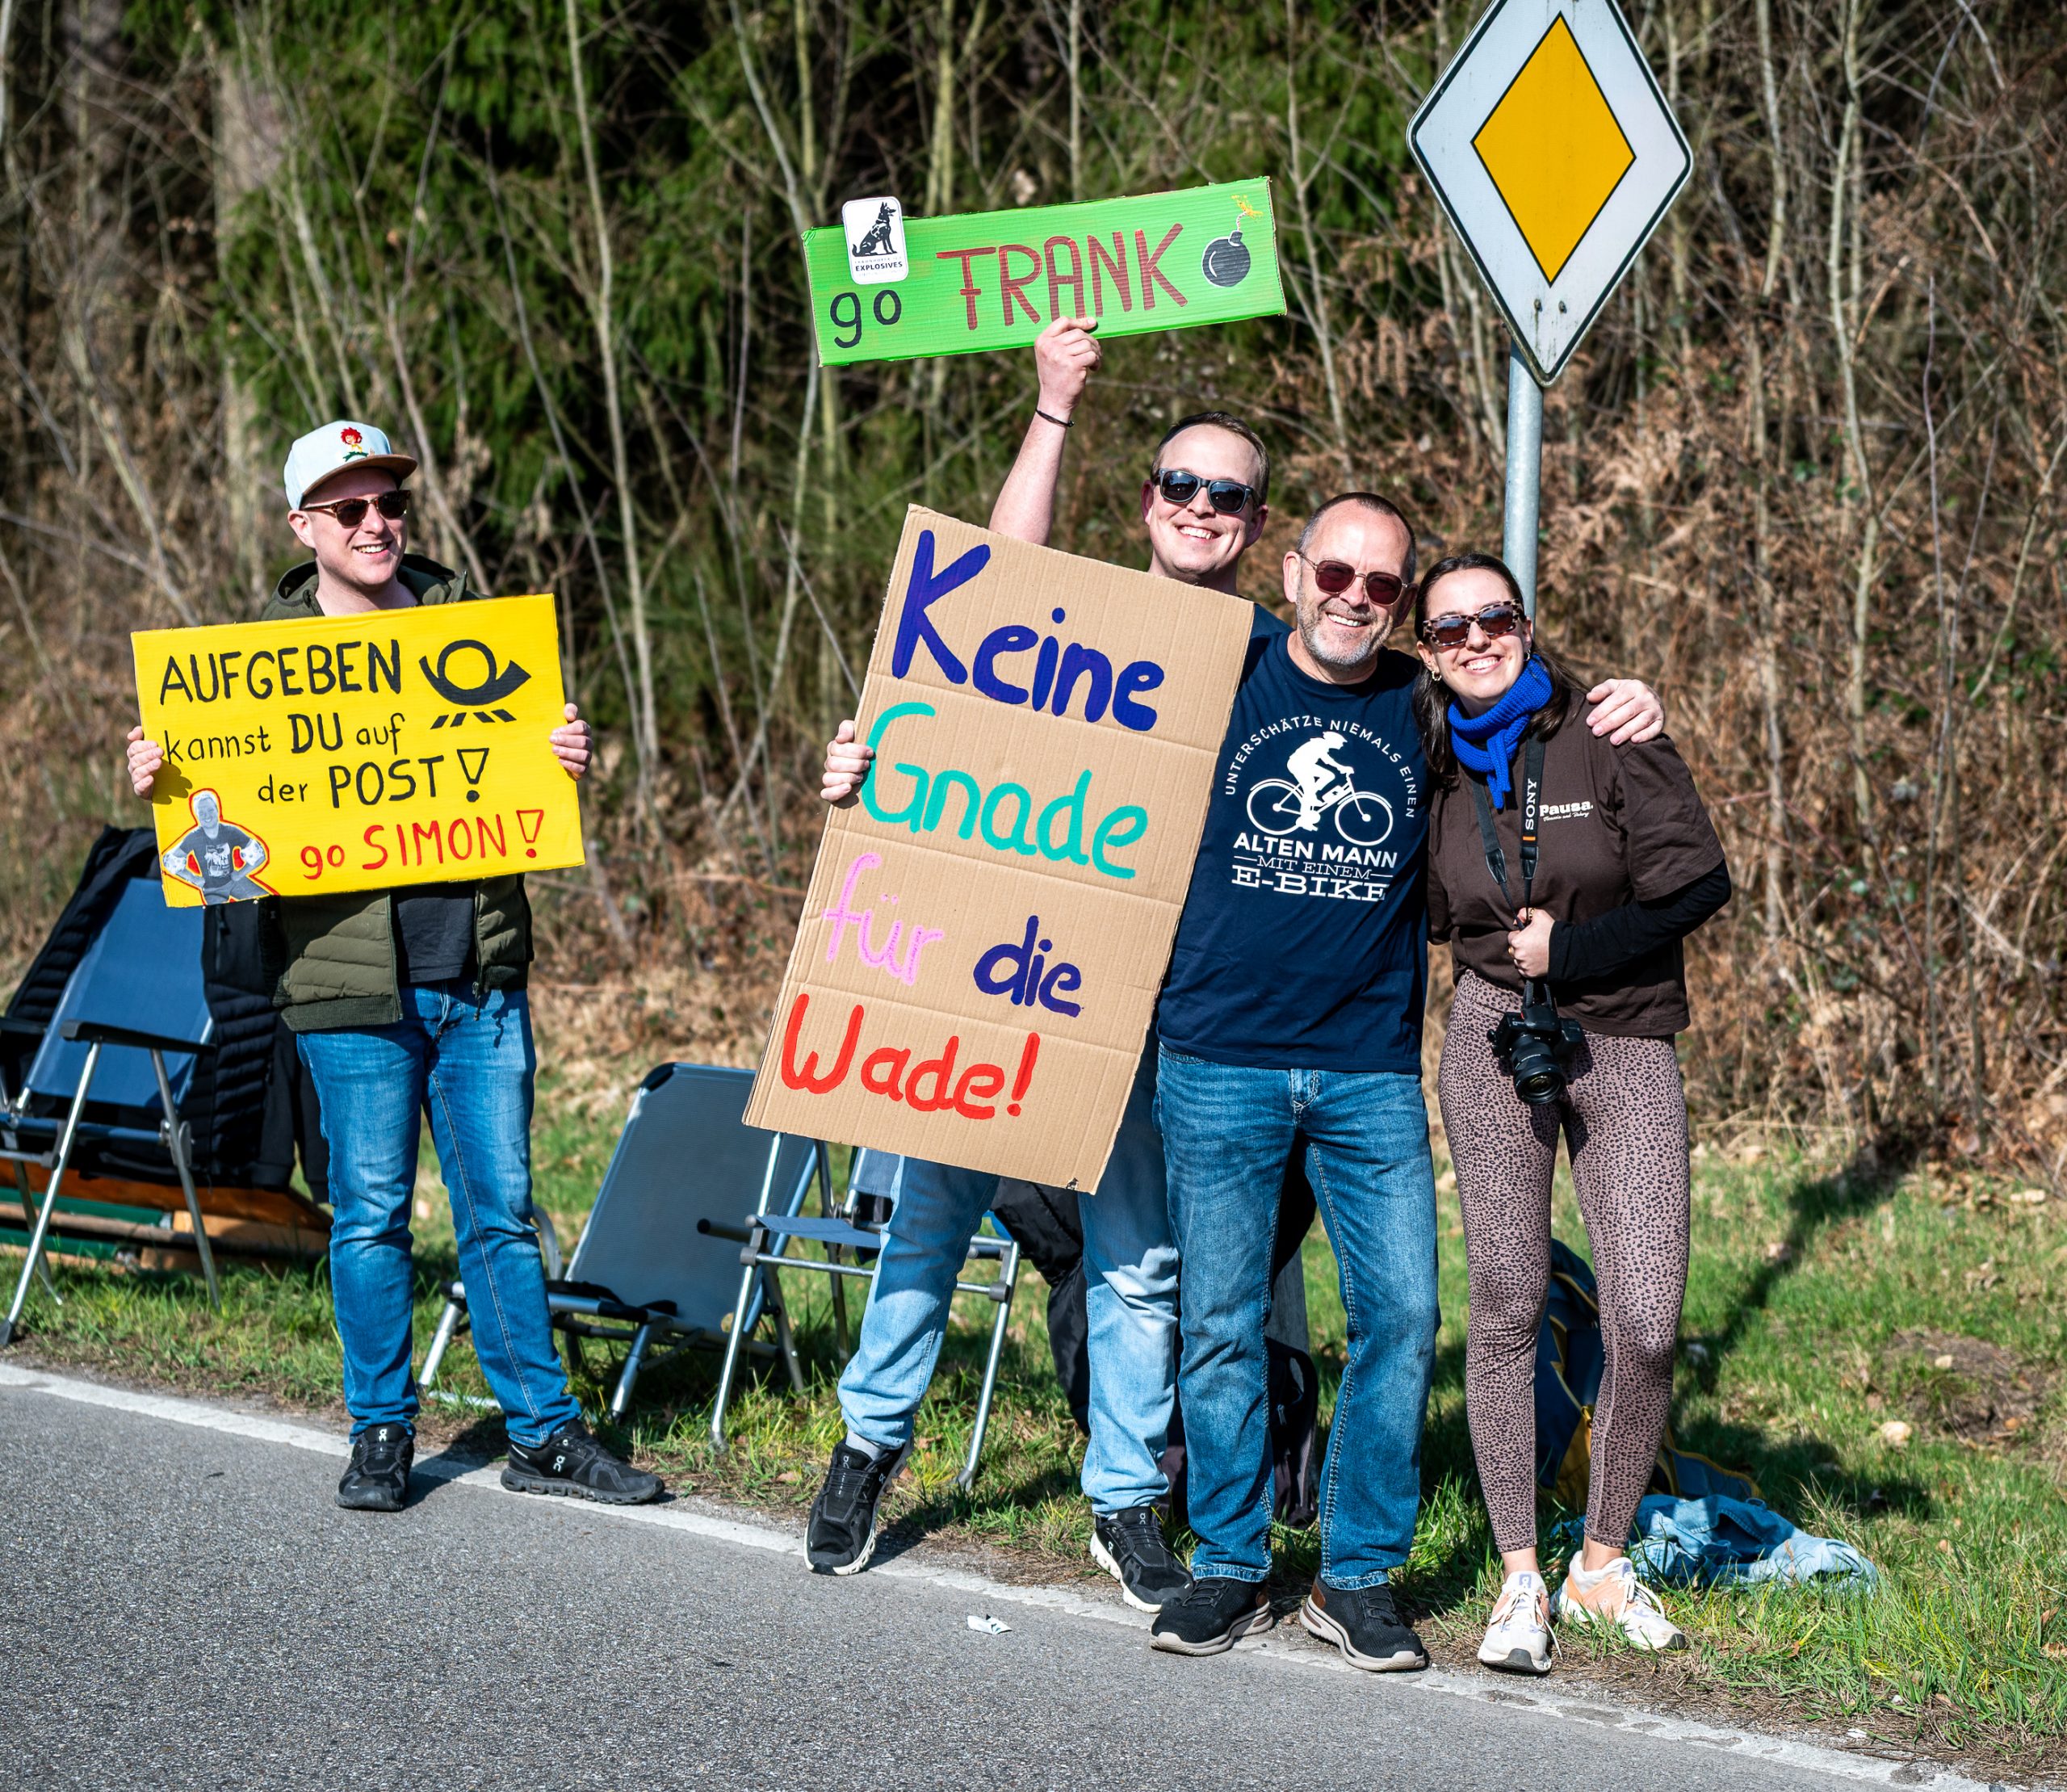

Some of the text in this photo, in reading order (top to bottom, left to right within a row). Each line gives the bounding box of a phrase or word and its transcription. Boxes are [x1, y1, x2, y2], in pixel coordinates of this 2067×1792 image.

[829, 222, 1189, 349] go FRANK
[855, 261, 903, 271] EXPLOSIVES
[892, 529, 1164, 731] Keine
[160, 639, 402, 705] AUFGEBEN
[164, 712, 405, 765] kannst DU auf
[258, 774, 308, 804] der
[862, 702, 1148, 879] Gnade
[1225, 715, 1417, 818] UNTERSCHÄTZE NIEMALS EINEN
[1524, 778, 1537, 830] SONY
[300, 844, 345, 879] go
[1233, 833, 1398, 868] ALTEN MANN
[1256, 855, 1372, 880] MIT EINEM
[1231, 864, 1390, 902] E-BIKE
[822, 852, 1084, 1018] für die
[781, 993, 1041, 1120] Wade!
